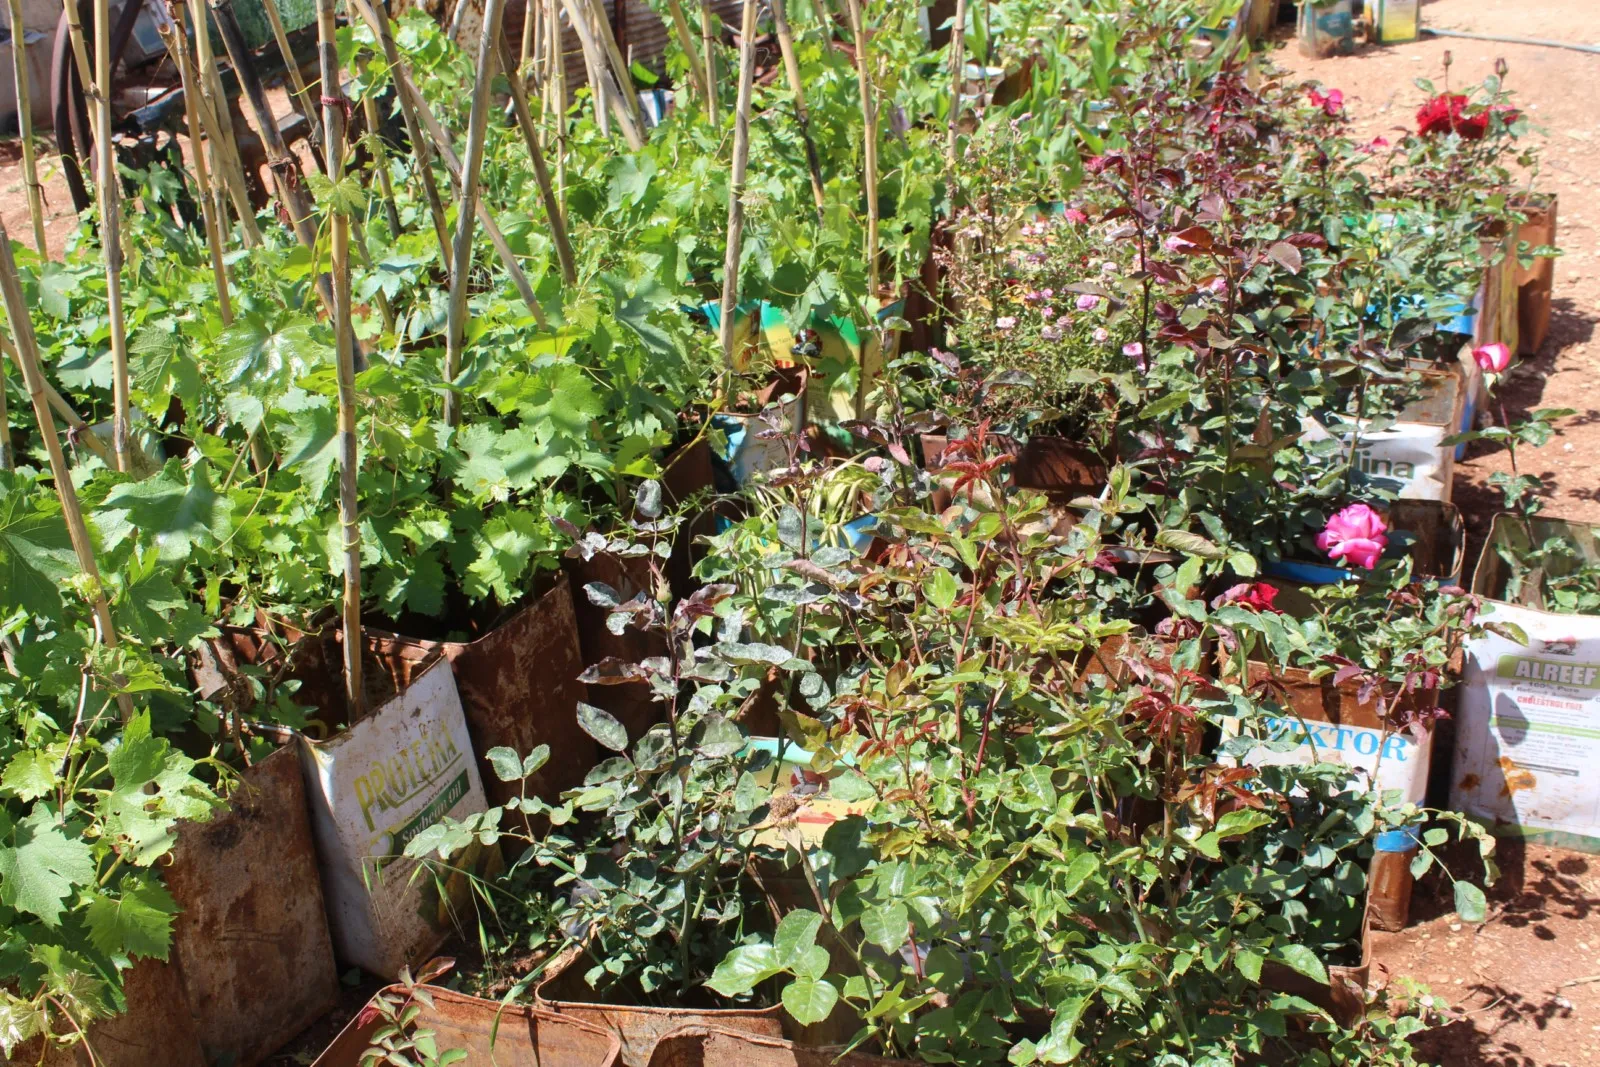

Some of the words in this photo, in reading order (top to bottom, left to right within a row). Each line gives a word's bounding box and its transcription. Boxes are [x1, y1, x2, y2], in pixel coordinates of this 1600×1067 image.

[1515, 660, 1598, 686] ALREEF
[402, 799, 449, 842] Soybean
[448, 777, 462, 804] Oil
